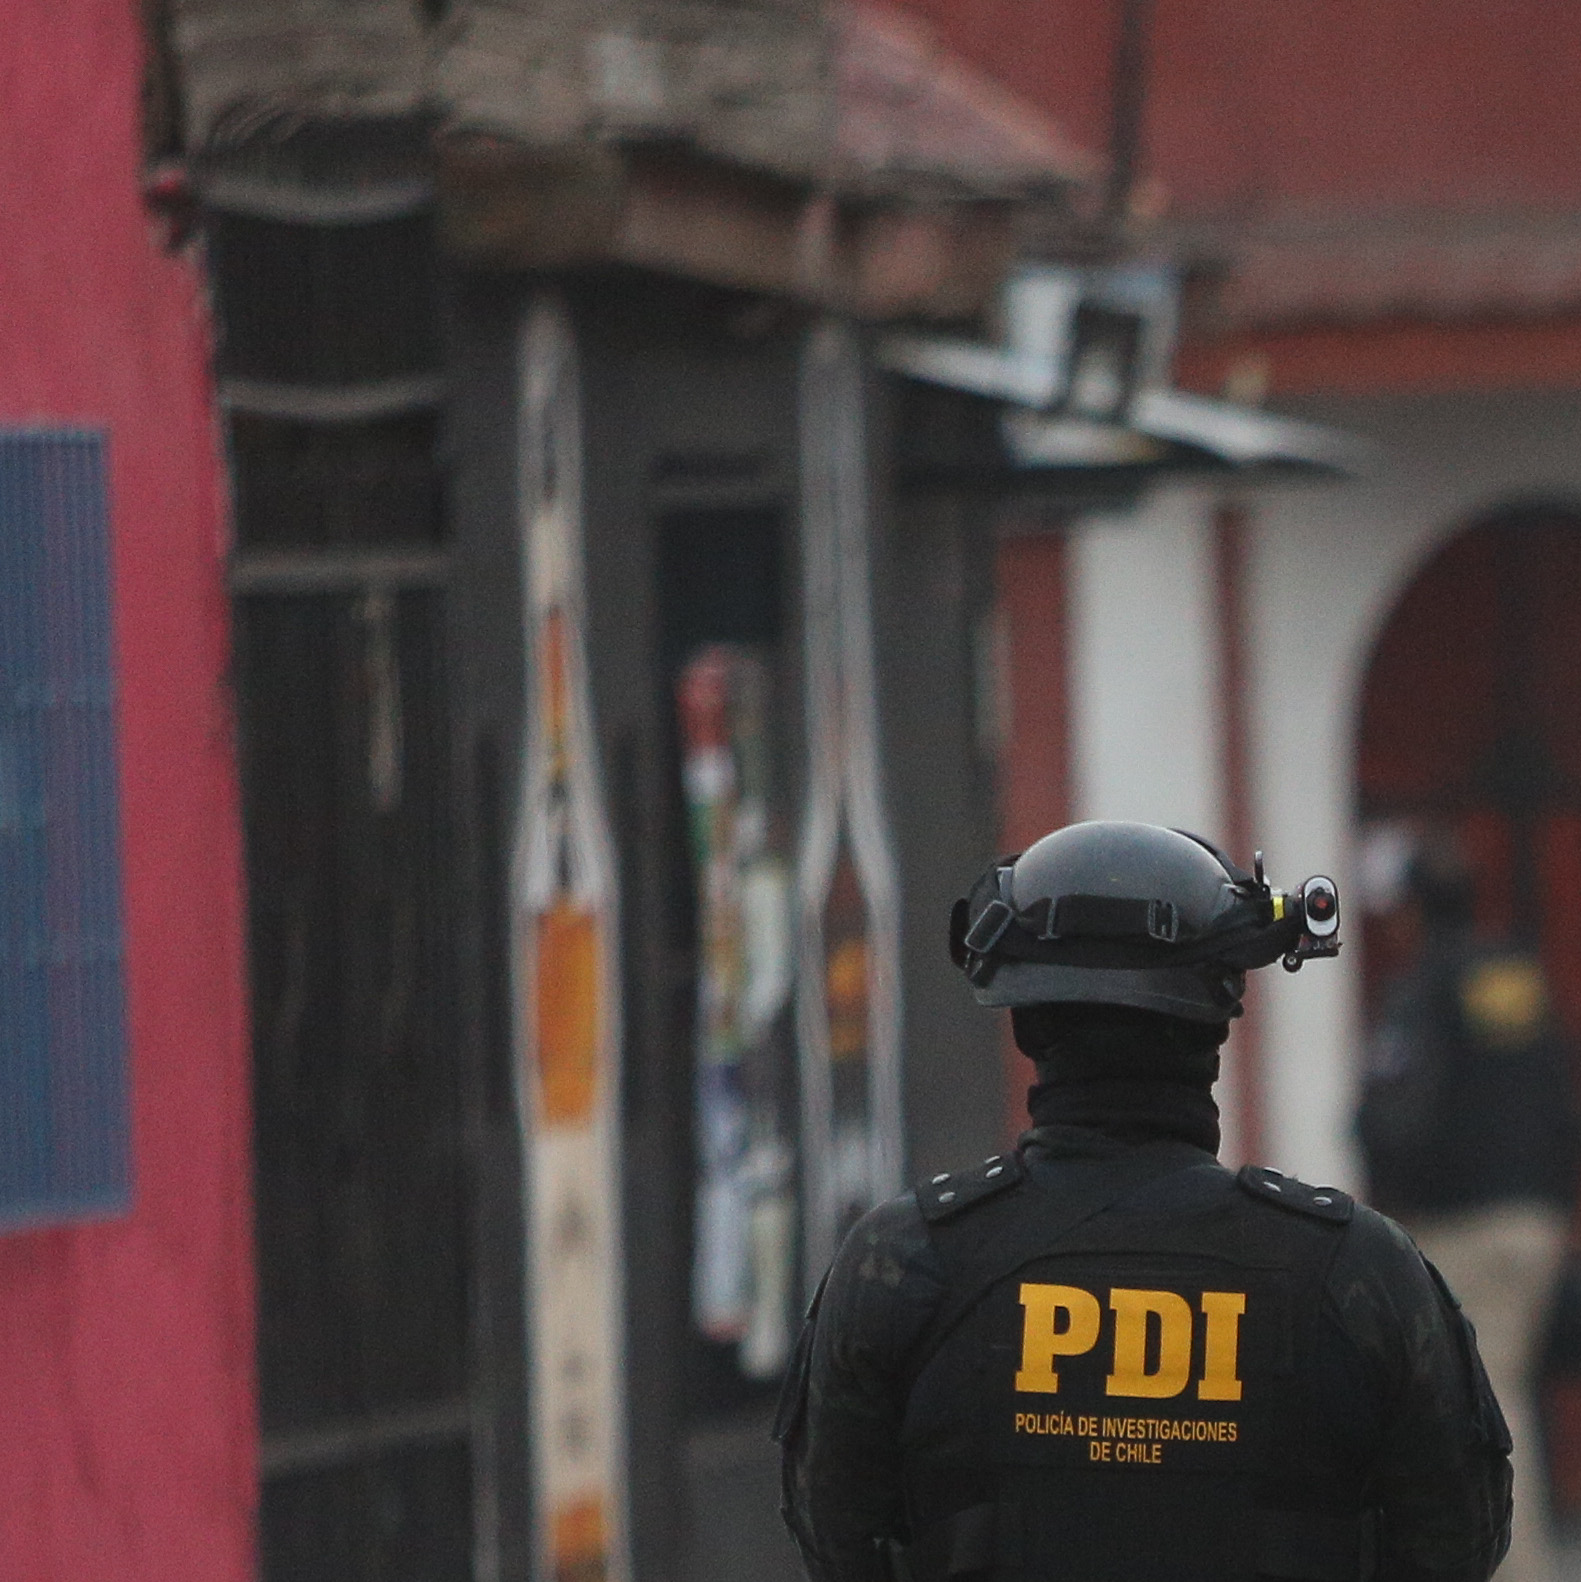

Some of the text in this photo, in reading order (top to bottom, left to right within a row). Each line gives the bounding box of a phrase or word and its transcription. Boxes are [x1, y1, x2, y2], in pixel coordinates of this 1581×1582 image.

[1014, 1283, 1247, 1401] PDI
[1015, 1411, 1238, 1442] POLICÍA DE INVESTIGACIONES
[1090, 1441, 1162, 1464] DE CHILE
